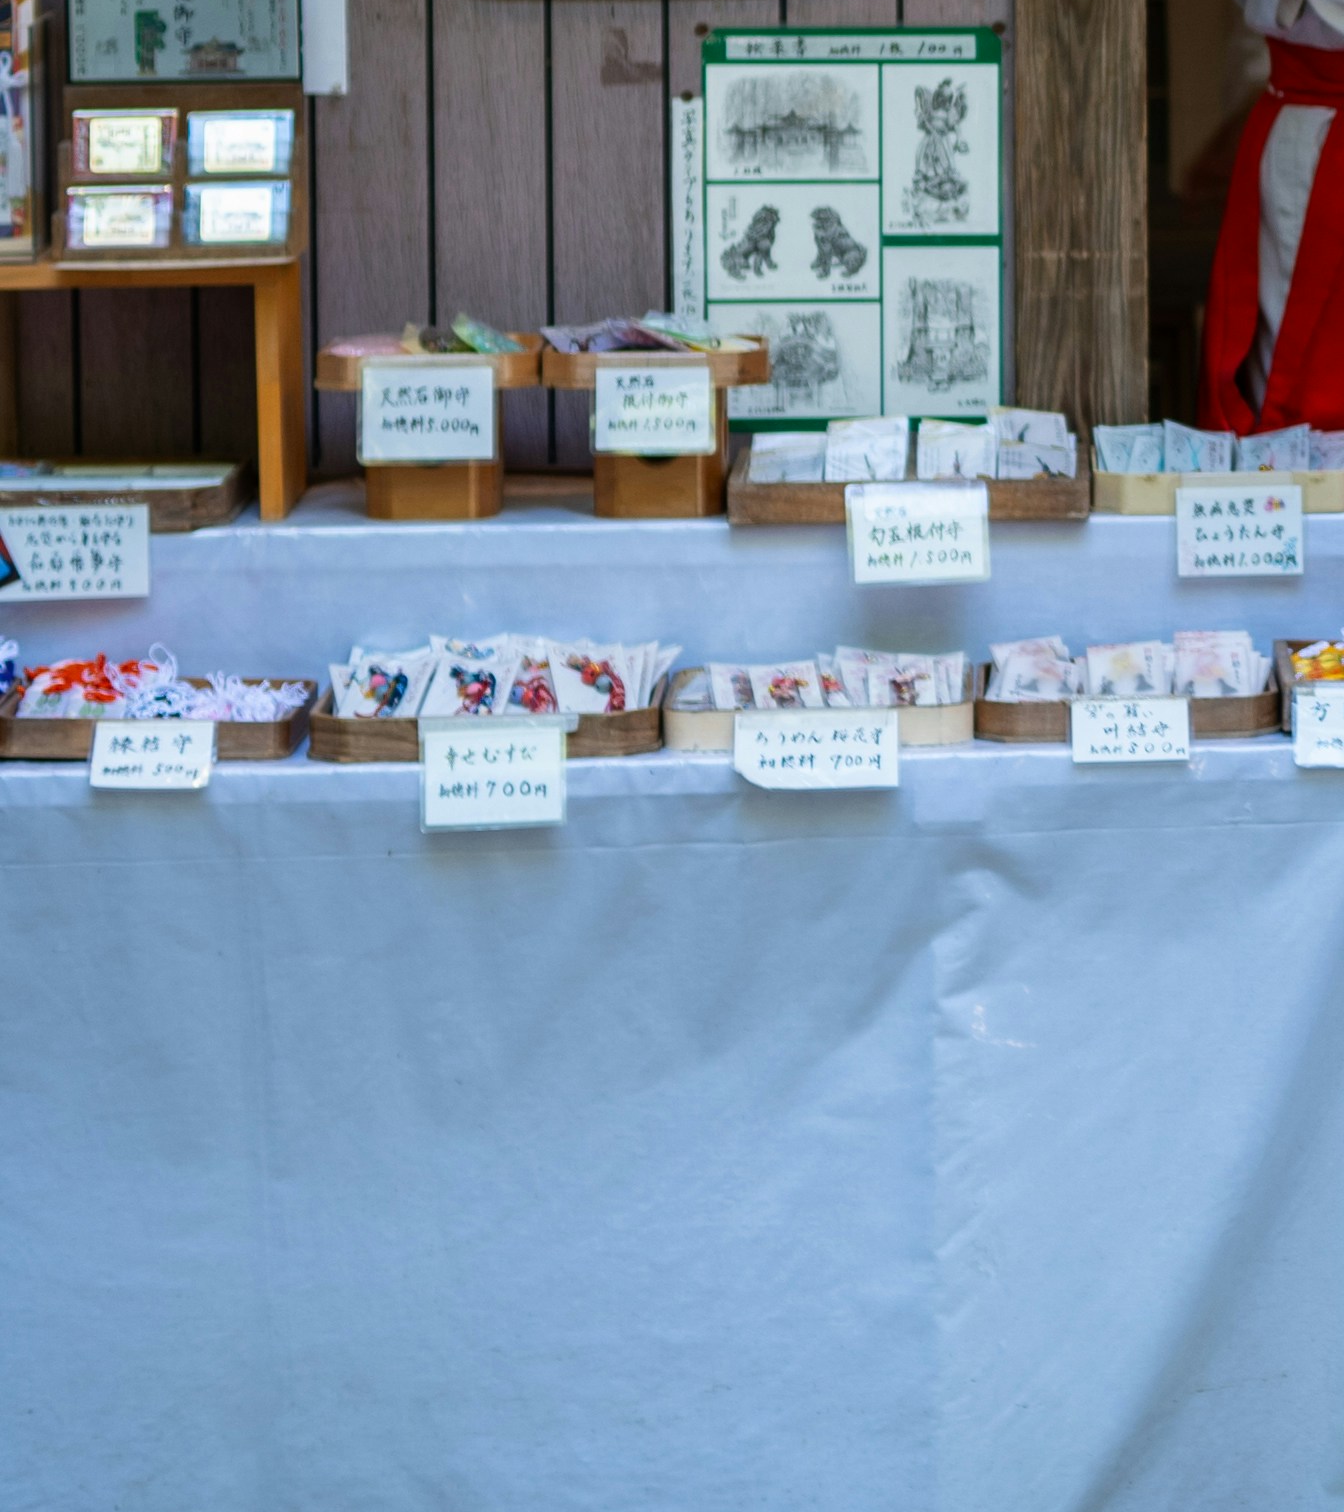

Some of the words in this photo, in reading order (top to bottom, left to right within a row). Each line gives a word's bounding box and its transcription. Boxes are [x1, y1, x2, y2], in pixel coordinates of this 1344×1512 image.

[616, 375, 654, 390] 天然石
[380, 385, 470, 409] 天然石御守
[1195, 524, 1285, 542] ひょうたん守
[445, 744, 538, 771] 幸せむすび
[830, 753, 881, 770] 700円
